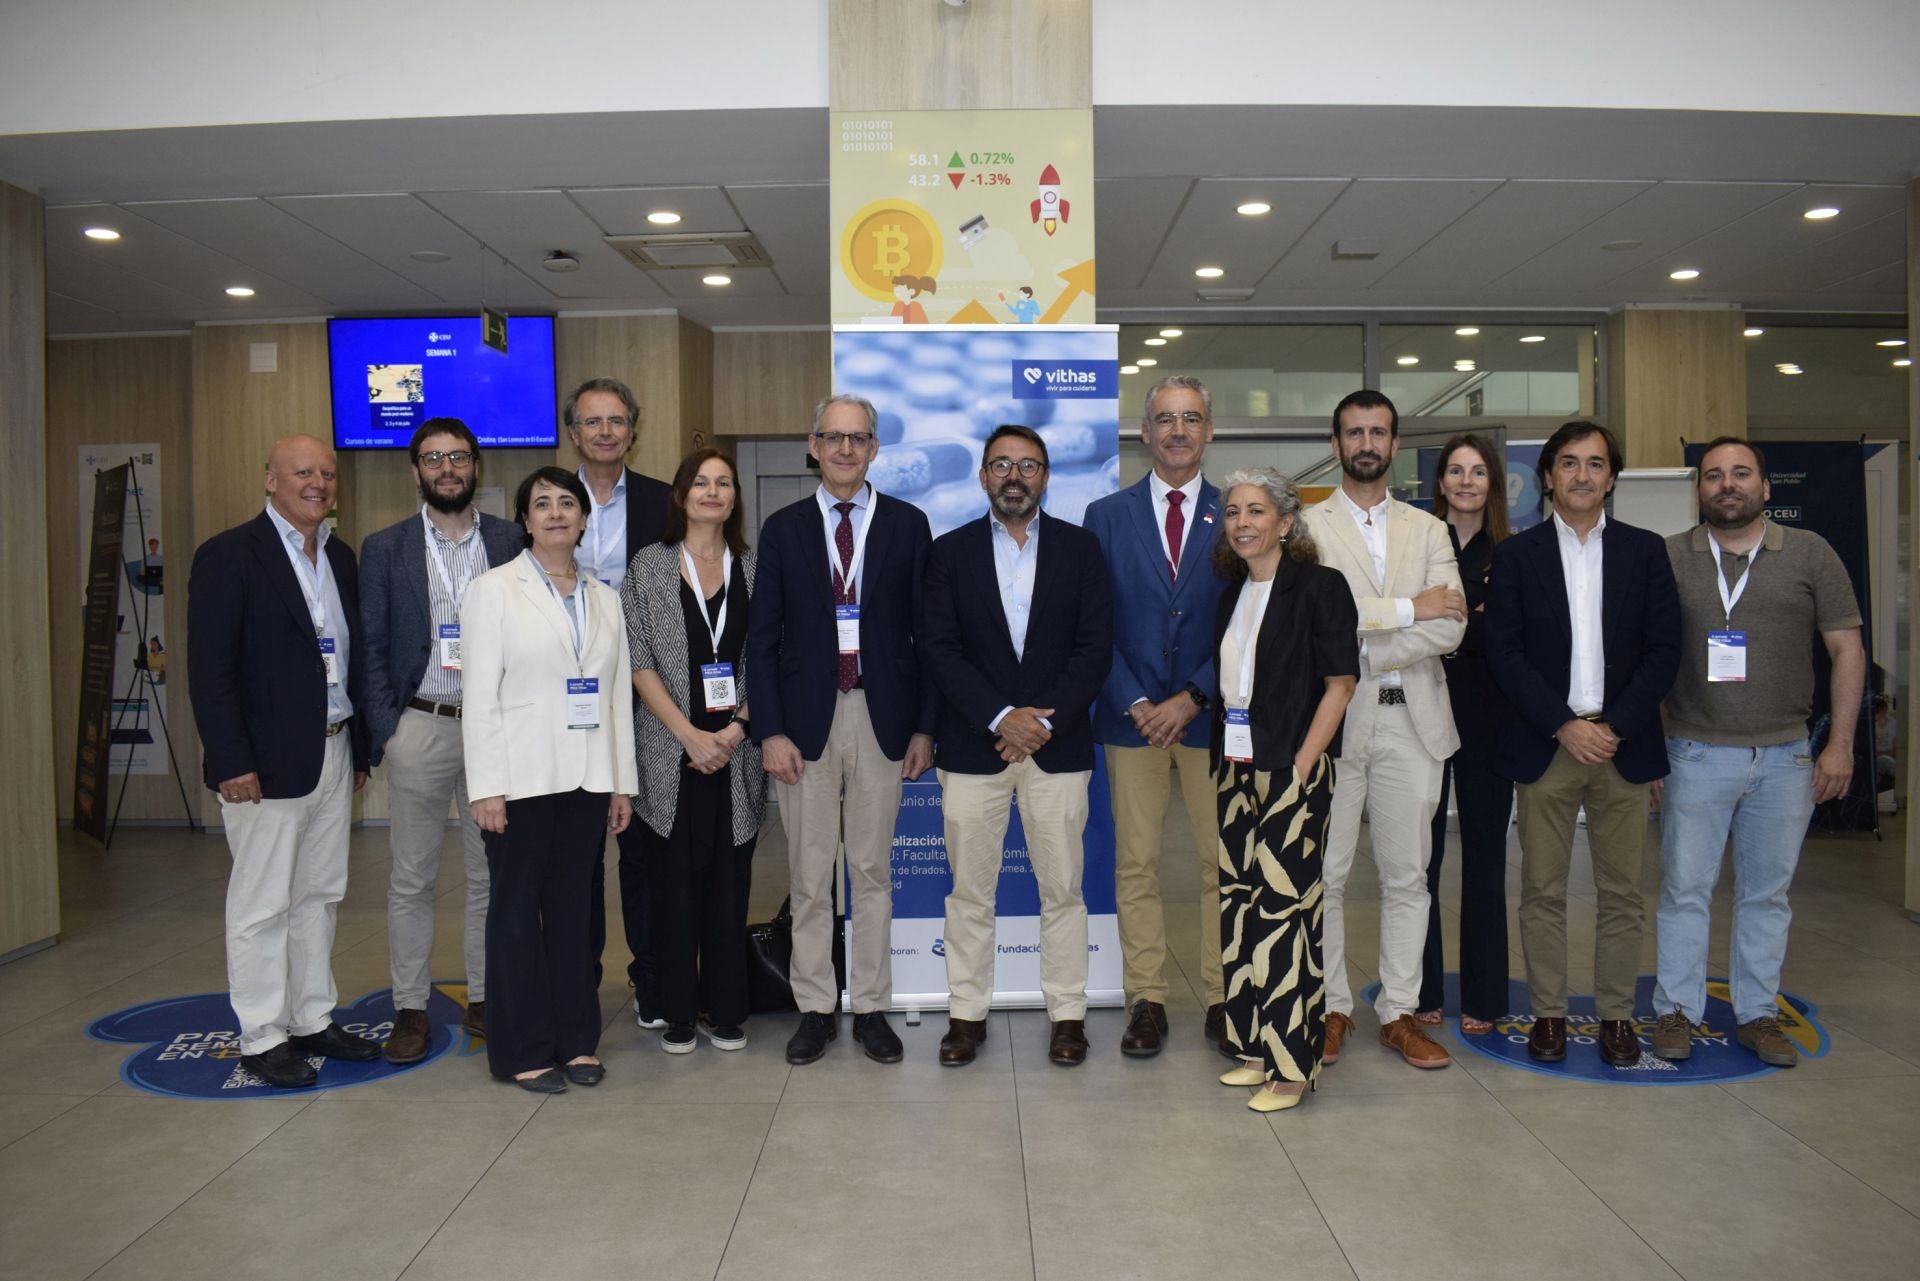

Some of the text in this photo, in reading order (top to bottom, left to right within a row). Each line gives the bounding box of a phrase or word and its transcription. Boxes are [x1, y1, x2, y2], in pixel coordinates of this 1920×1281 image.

[842, 120, 893, 130] 01010101
[842, 131, 893, 141] 01010101
[842, 142, 893, 152] 01010101
[909, 152, 1014, 166] 58.1 0.72%
[909, 173, 1011, 186] 43.2 -1.3%
[426, 349, 452, 357] SEMANA
[1045, 369, 1097, 383] vithas
[1774, 509, 1798, 518] CEU
[900, 795, 942, 807] unio de
[892, 834, 945, 847] alización
[903, 849, 946, 861] Faculta
[897, 866, 909, 875] de
[1000, 864, 1028, 873] omea.
[890, 947, 919, 956] boran:
[997, 943, 1041, 954] Fundació
[156, 1051, 204, 1061] EN
